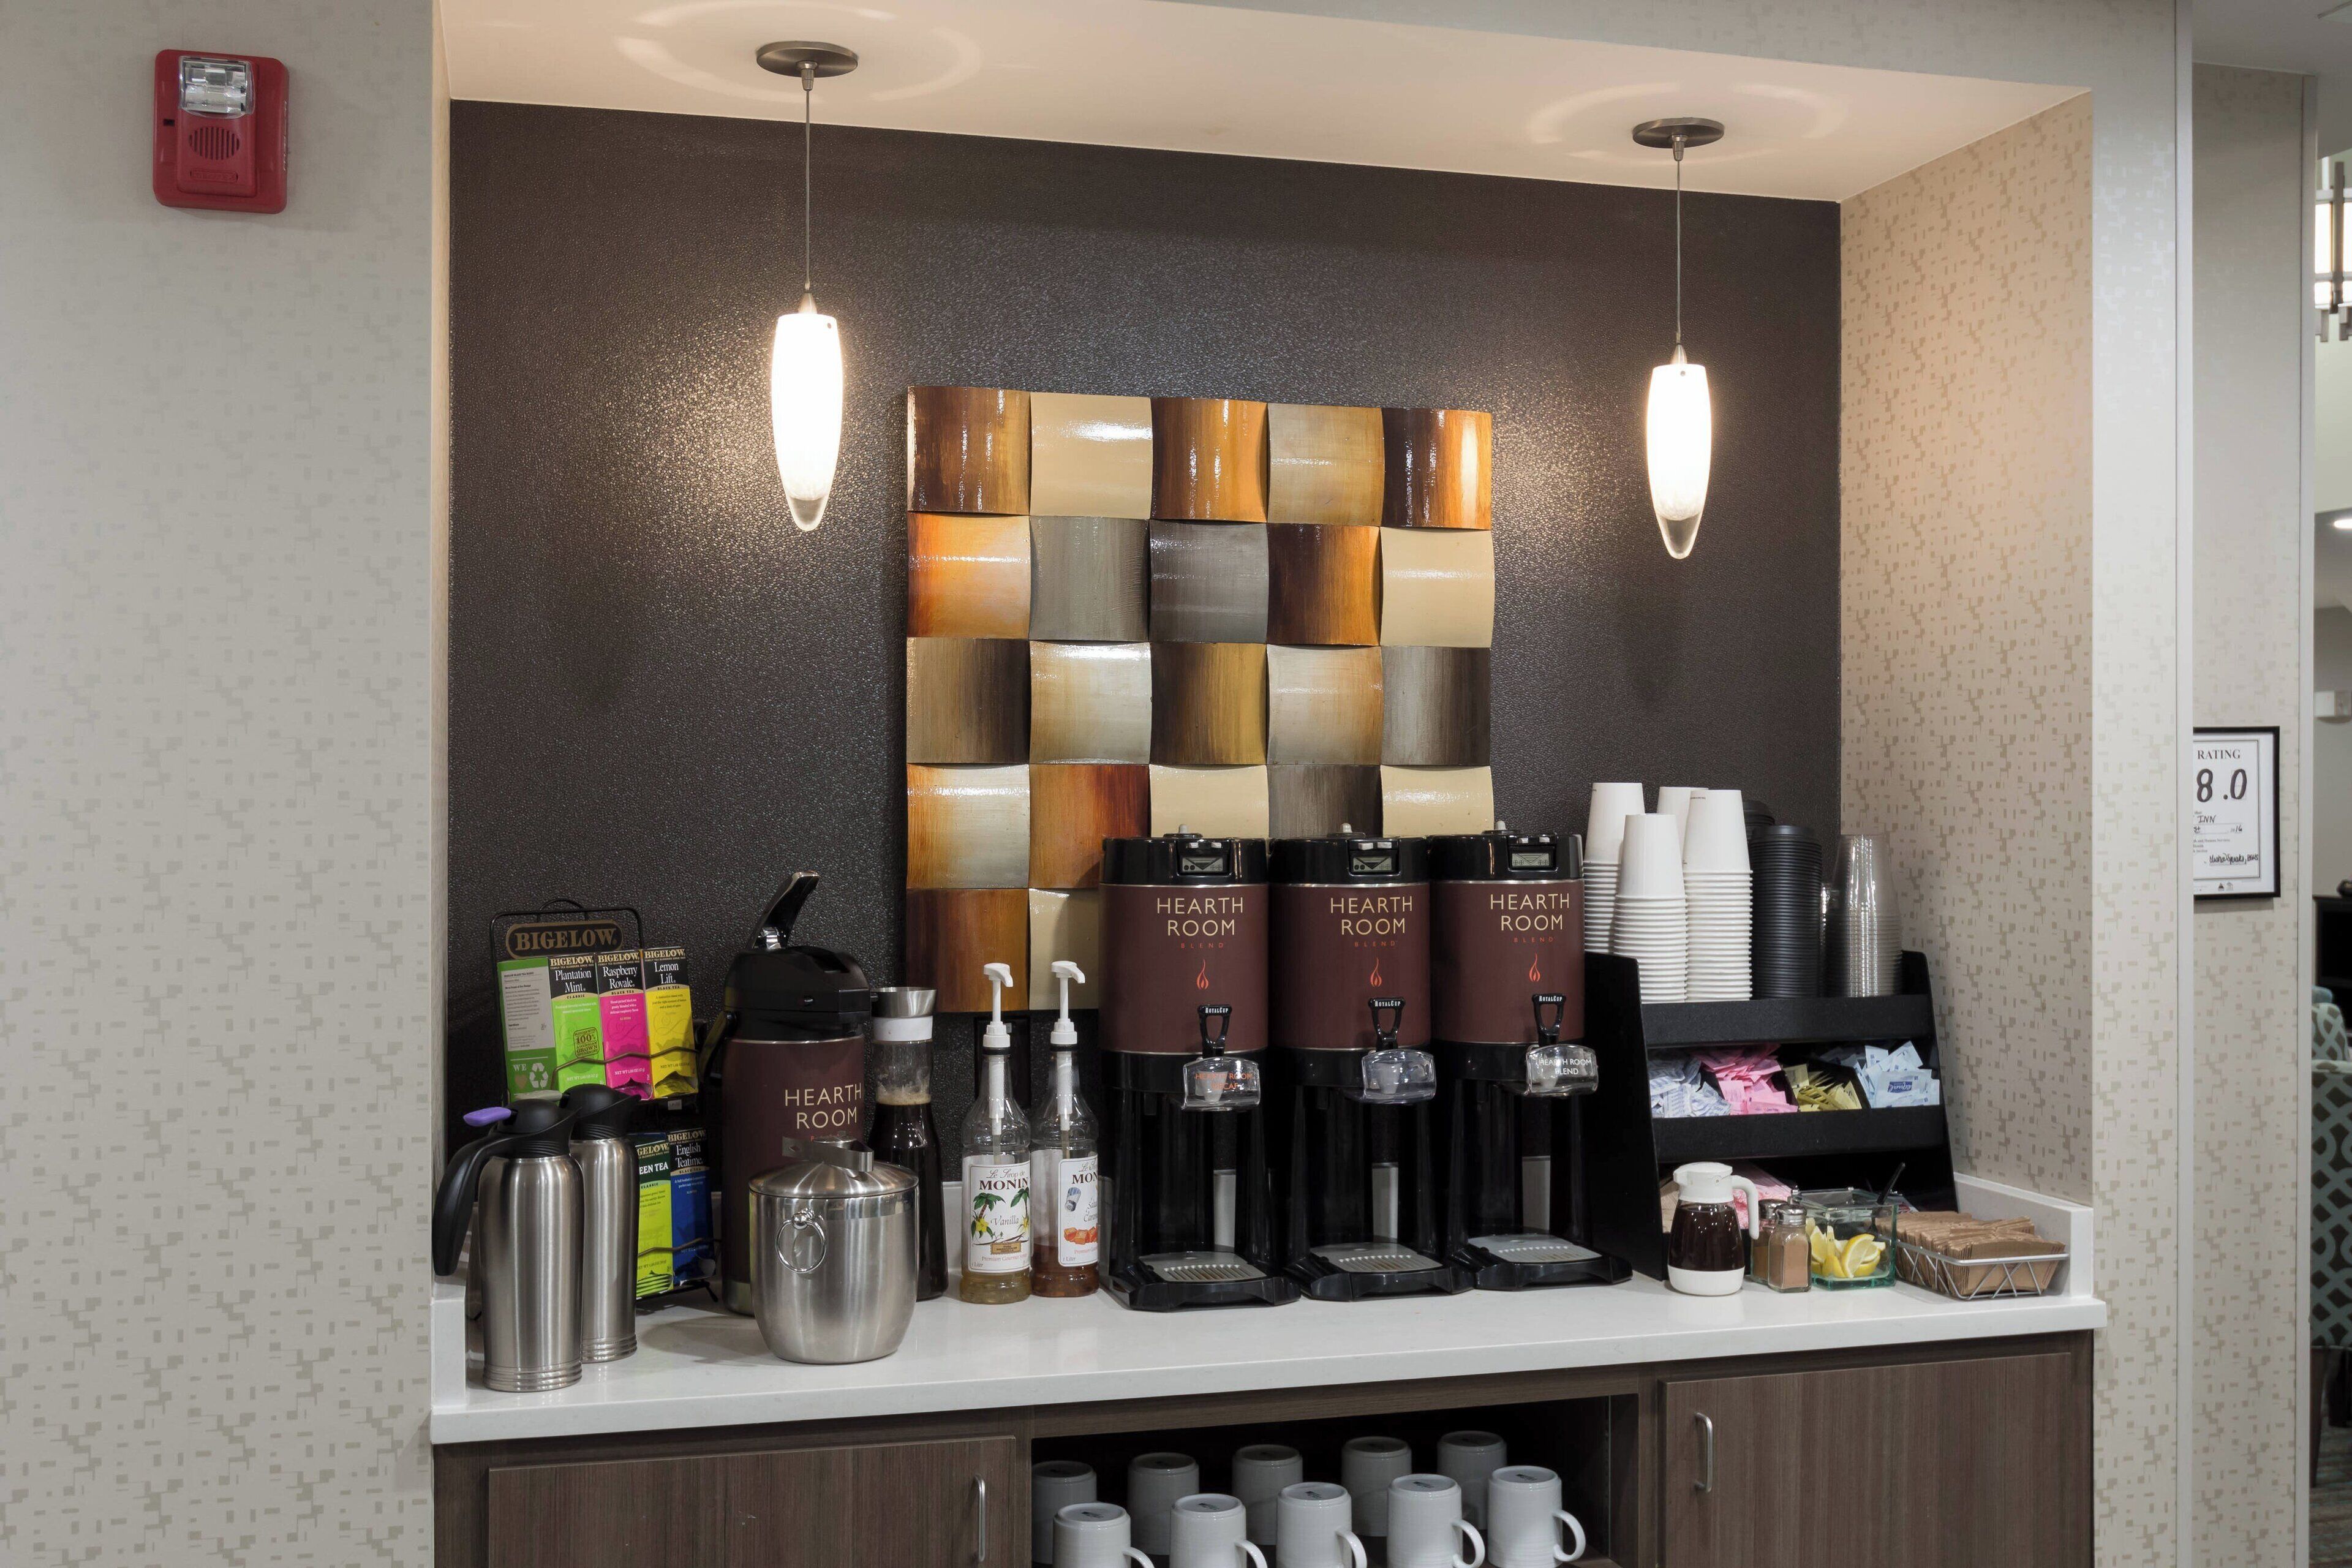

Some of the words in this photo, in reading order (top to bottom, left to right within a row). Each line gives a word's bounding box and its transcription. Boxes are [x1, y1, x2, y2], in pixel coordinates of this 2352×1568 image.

[2197, 749, 2241, 760] RATING
[2197, 815, 2216, 823] INN
[1157, 897, 1243, 914] HEARTH
[1330, 895, 1412, 914] HEARTH
[1490, 892, 1570, 910] HEARTH
[1167, 919, 1235, 937] ROOM
[1341, 918, 1406, 935] ROOM
[1501, 914, 1563, 932] ROOM
[515, 929, 617, 950] BIGELOW
[598, 952, 639, 963] BIGELOW
[644, 949, 685, 959] BIGELOW
[550, 956, 594, 967] BIGELOW
[654, 962, 679, 973] Lemon
[555, 968, 592, 981] Plantation
[603, 965, 638, 978] Raspberry
[609, 978, 633, 989] Royale
[660, 974, 674, 984] Lift
[565, 982, 583, 993] Mint
[785, 1082, 861, 1107] HEARTH
[796, 1106, 858, 1129] ROOM
[668, 1129, 706, 1142] BIGELOW
[637, 1142, 669, 1156] GELOW
[676, 1142, 701, 1156] English
[639, 1164, 654, 1175] EEN
[654, 1161, 669, 1172] TEA
[676, 1156, 701, 1168] Teatime
[986, 1169, 998, 1178] Le
[979, 1177, 1028, 1190] MONIN
[990, 1215, 1020, 1226] Vanilla
